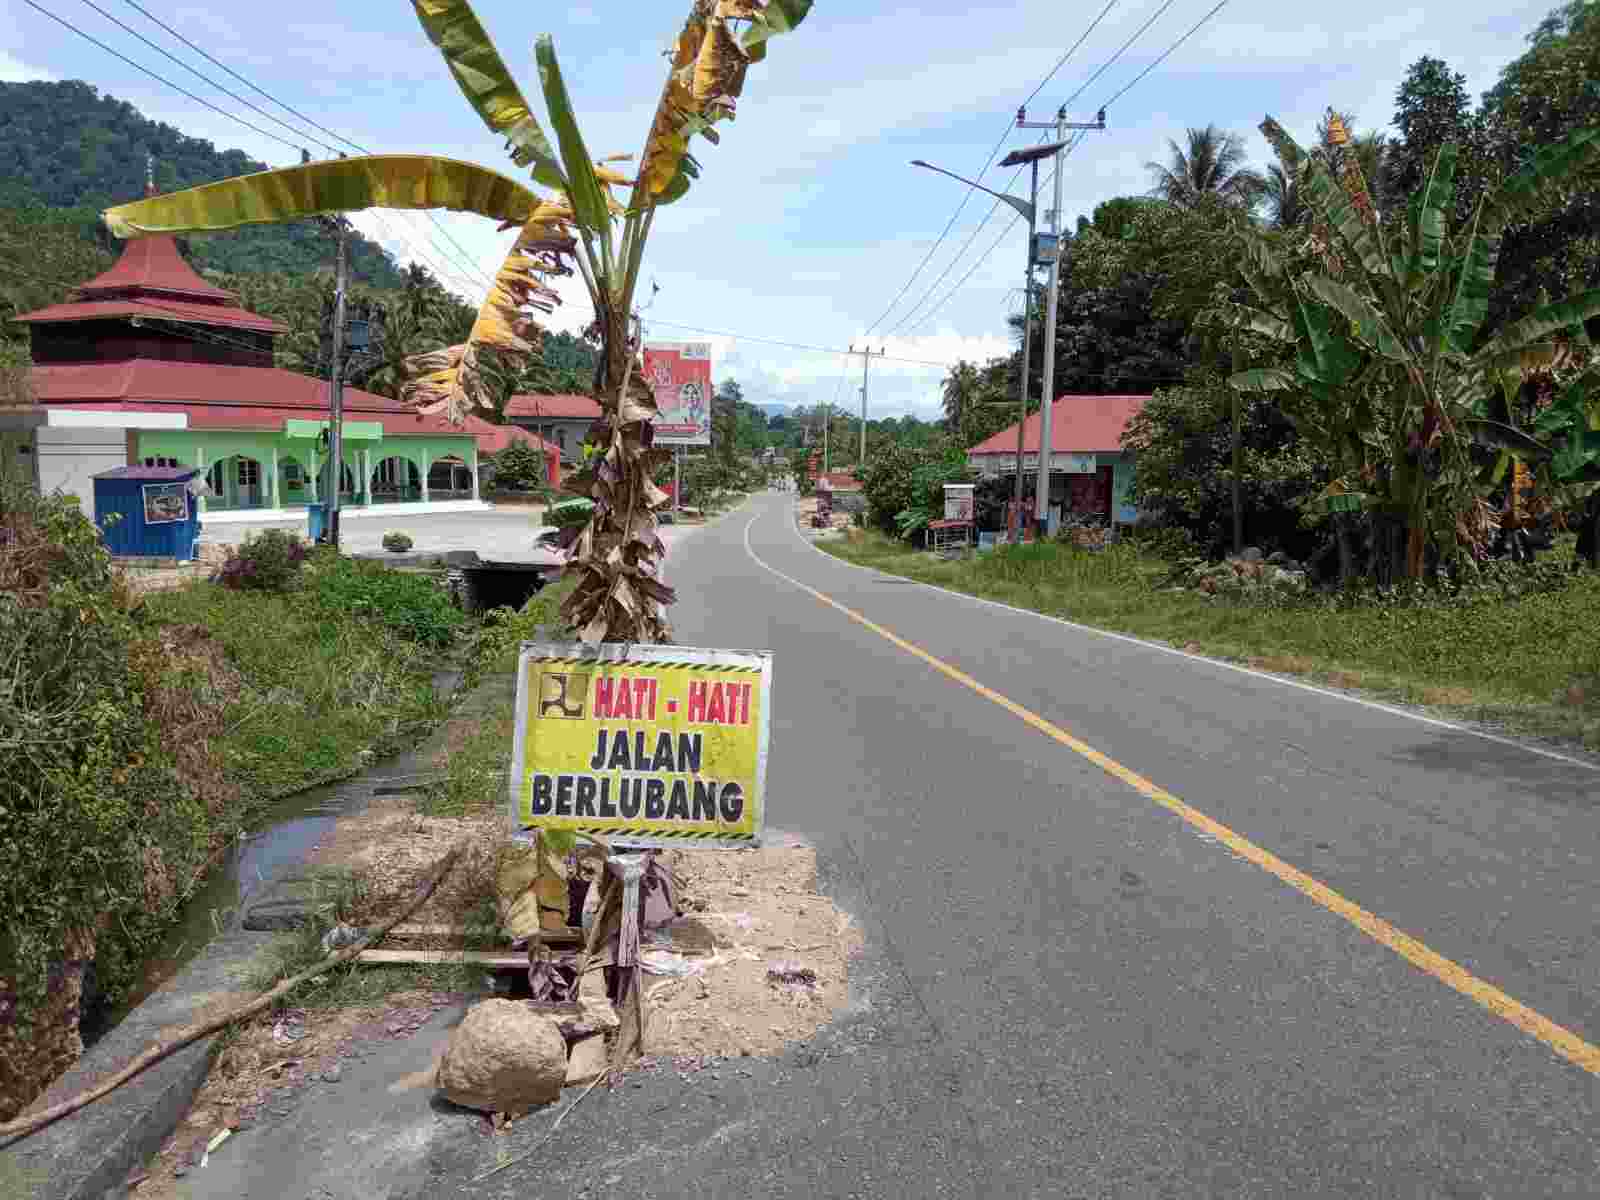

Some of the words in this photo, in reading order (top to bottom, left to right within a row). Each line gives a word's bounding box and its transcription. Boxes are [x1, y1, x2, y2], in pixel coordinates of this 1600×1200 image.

[593, 676, 657, 720] HATI
[687, 681, 752, 725] HATI
[590, 729, 702, 772] JALAN
[531, 774, 744, 822] BERLUBANG
